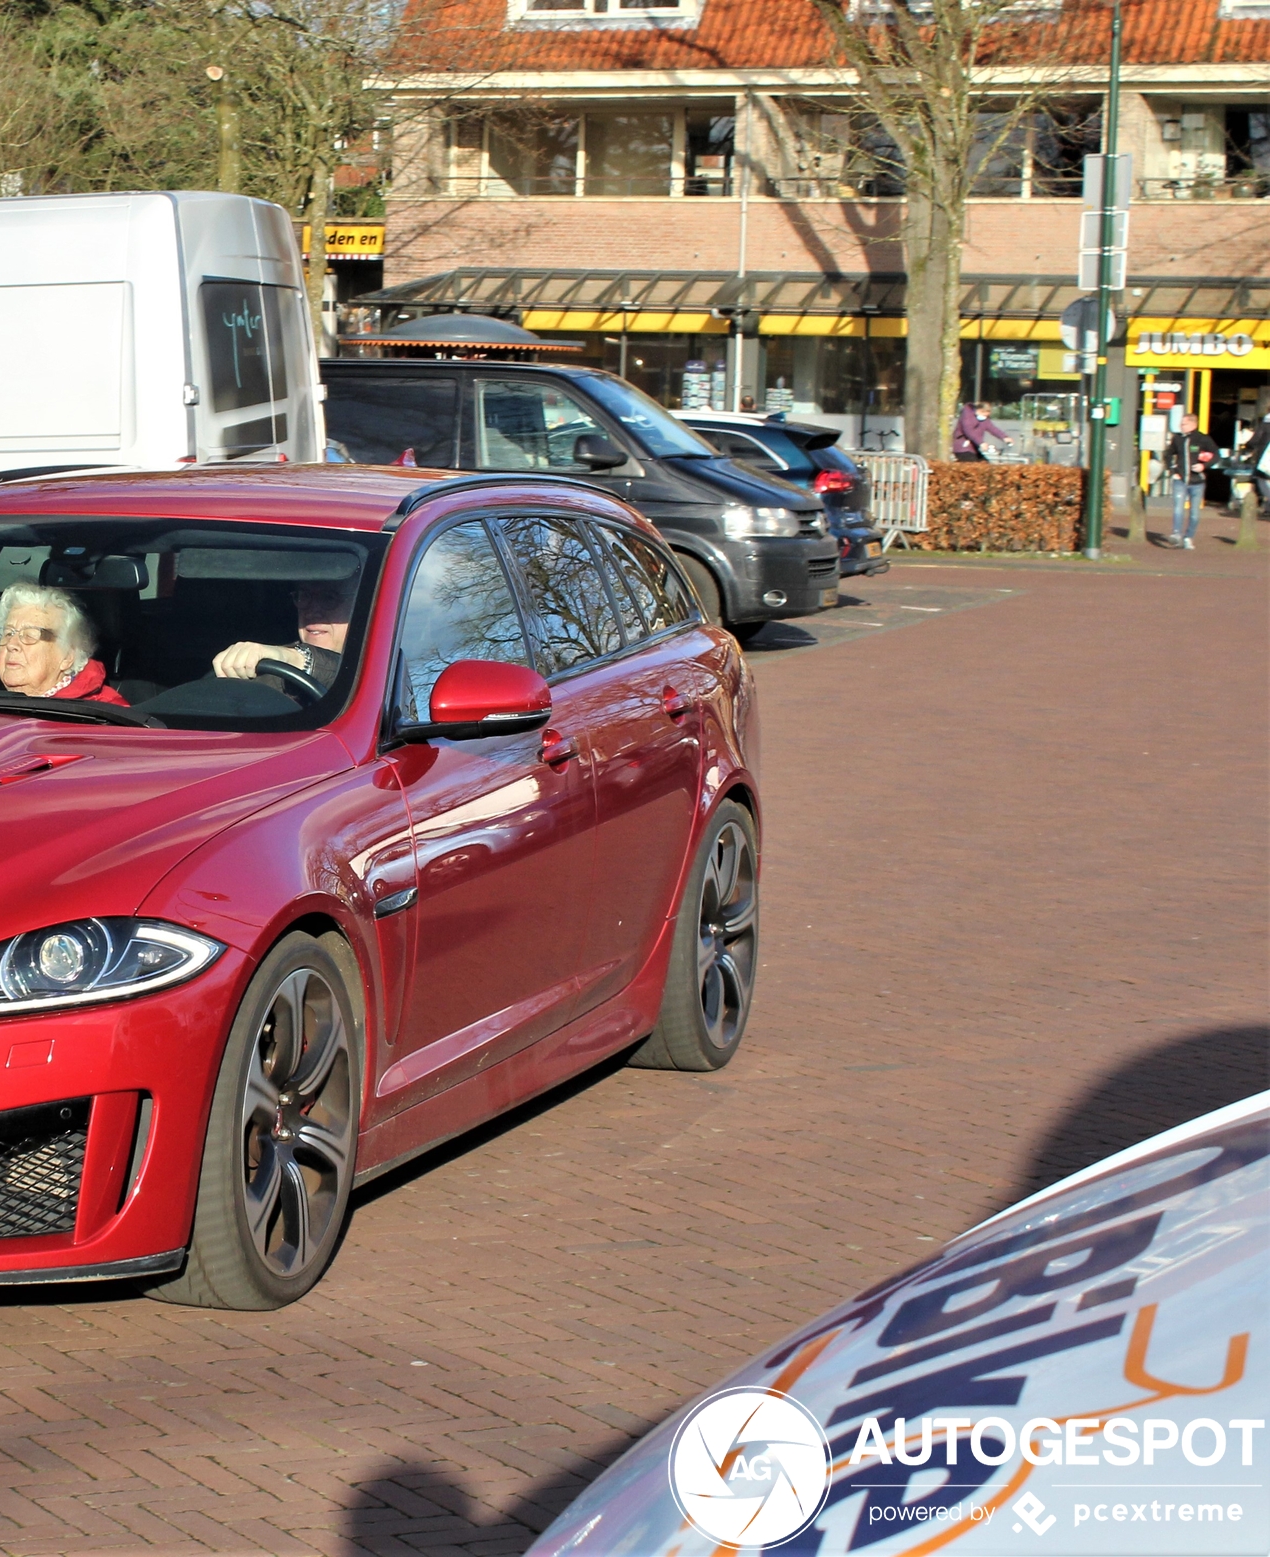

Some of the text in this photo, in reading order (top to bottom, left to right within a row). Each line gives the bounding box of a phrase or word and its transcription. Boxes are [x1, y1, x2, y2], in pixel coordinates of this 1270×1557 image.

[327, 231, 355, 246] den
[360, 234, 377, 246] en
[1134, 332, 1254, 356] JUMBO
